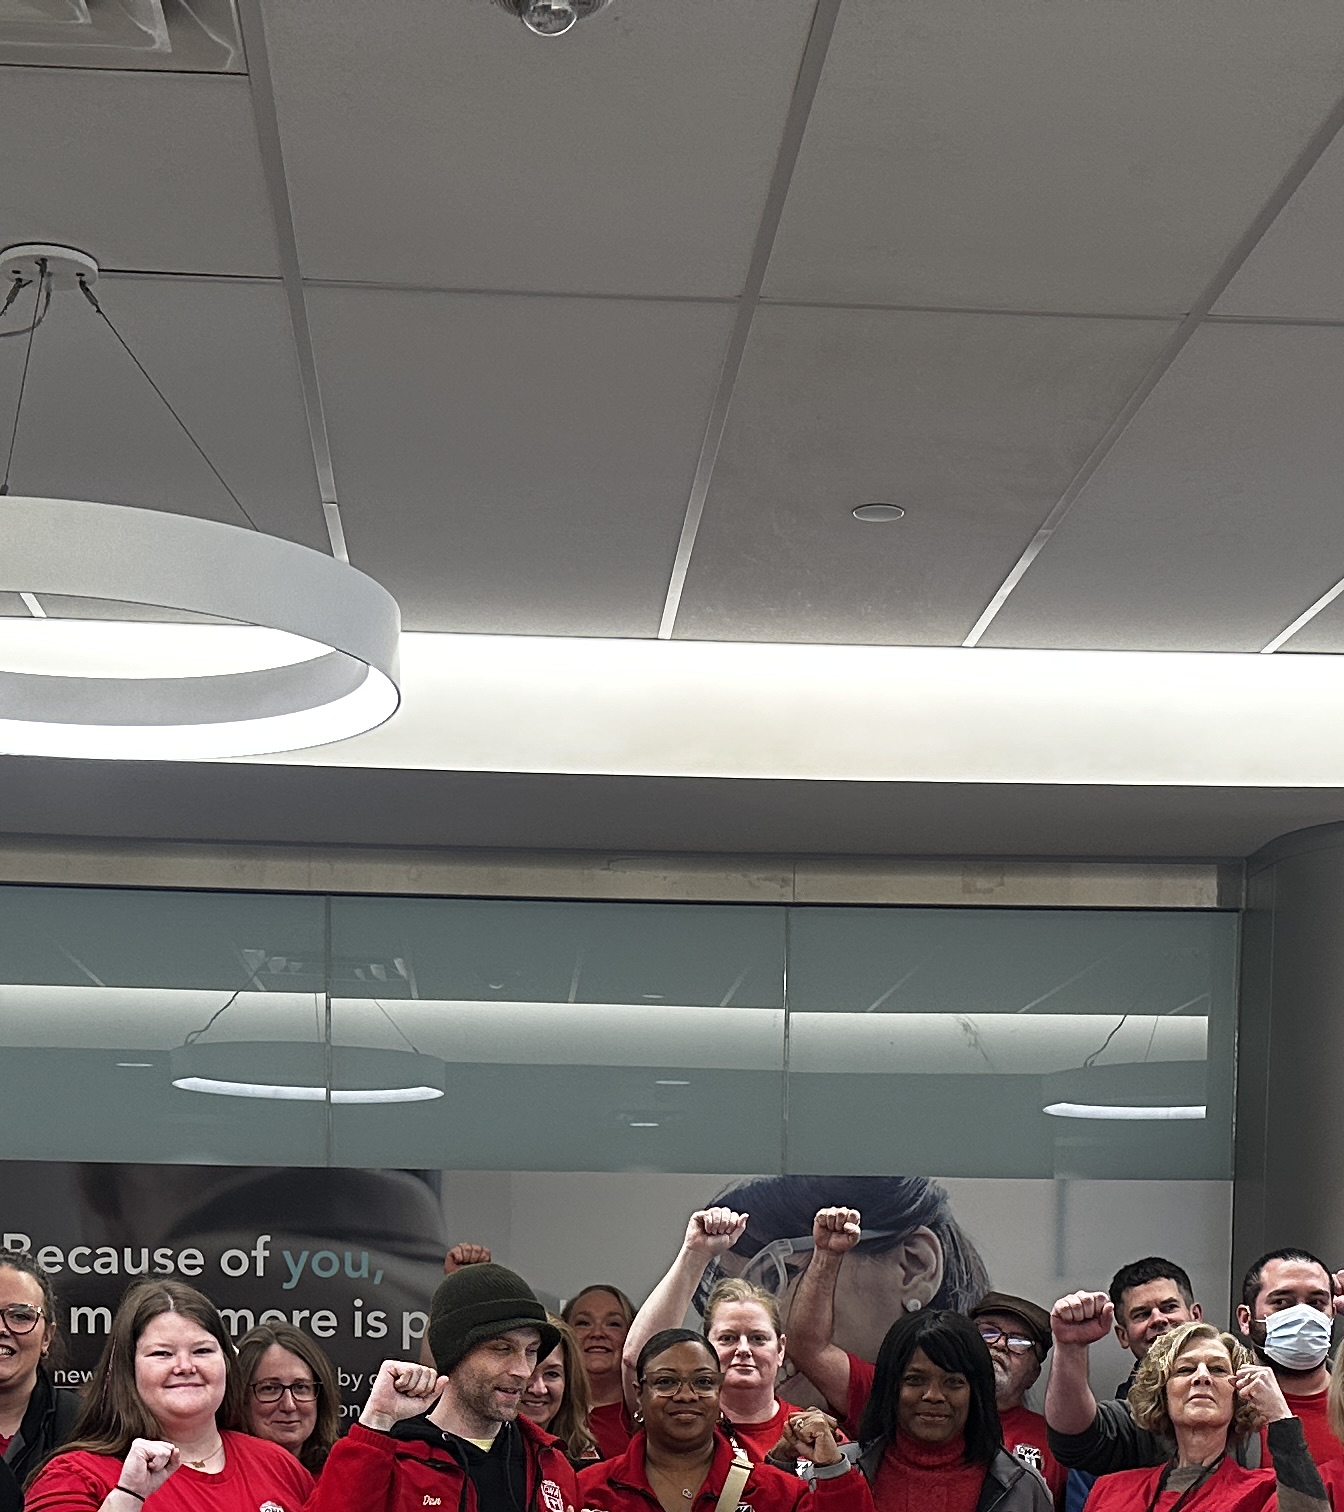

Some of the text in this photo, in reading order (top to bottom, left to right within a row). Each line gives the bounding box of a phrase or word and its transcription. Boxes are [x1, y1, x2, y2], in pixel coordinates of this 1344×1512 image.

[219, 1235, 272, 1277] of
[282, 1249, 383, 1289] you,
[353, 1298, 388, 1338] is
[337, 1366, 363, 1392] by
